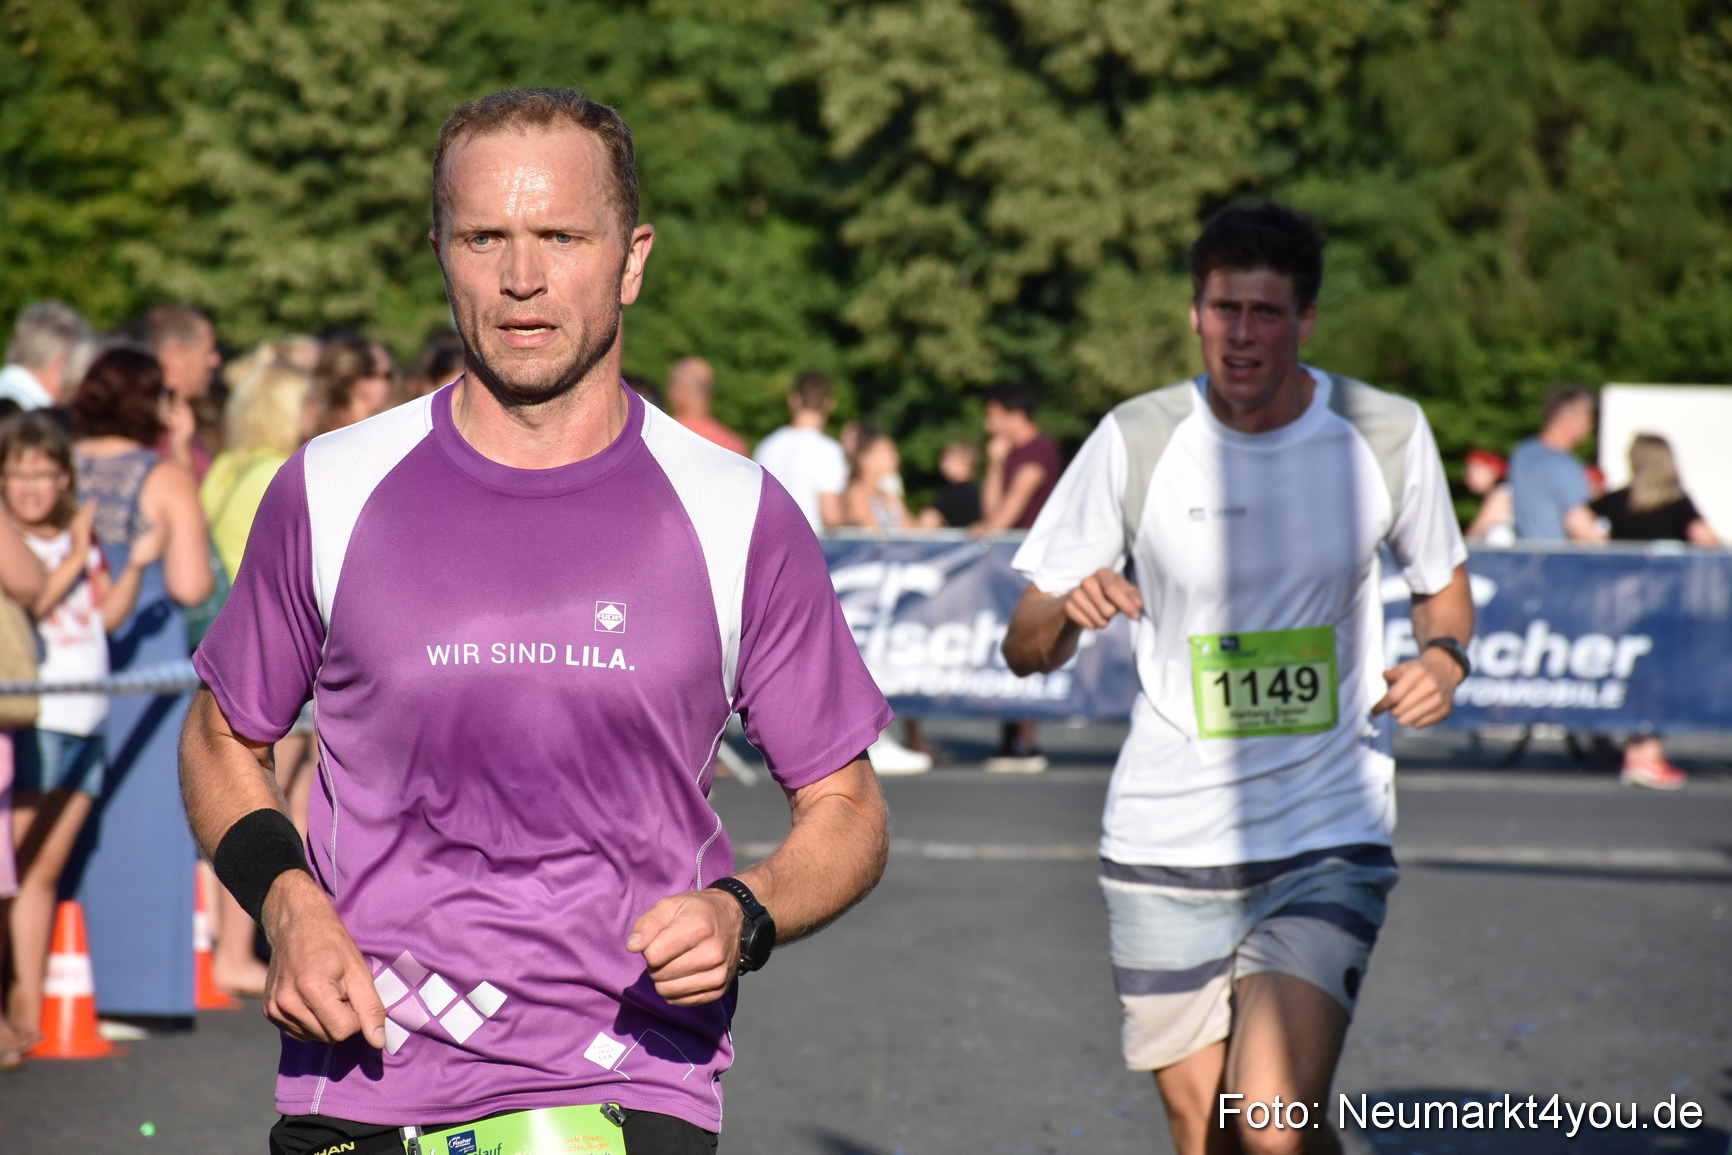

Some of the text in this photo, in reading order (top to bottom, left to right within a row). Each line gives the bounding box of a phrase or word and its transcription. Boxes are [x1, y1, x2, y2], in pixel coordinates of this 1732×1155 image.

[426, 642, 636, 671] WIR SIND LILA.
[848, 608, 1097, 669] isch
[1384, 617, 1653, 680] Fcher
[1214, 666, 1319, 707] 1149
[1453, 676, 1629, 709] TOMOBILE
